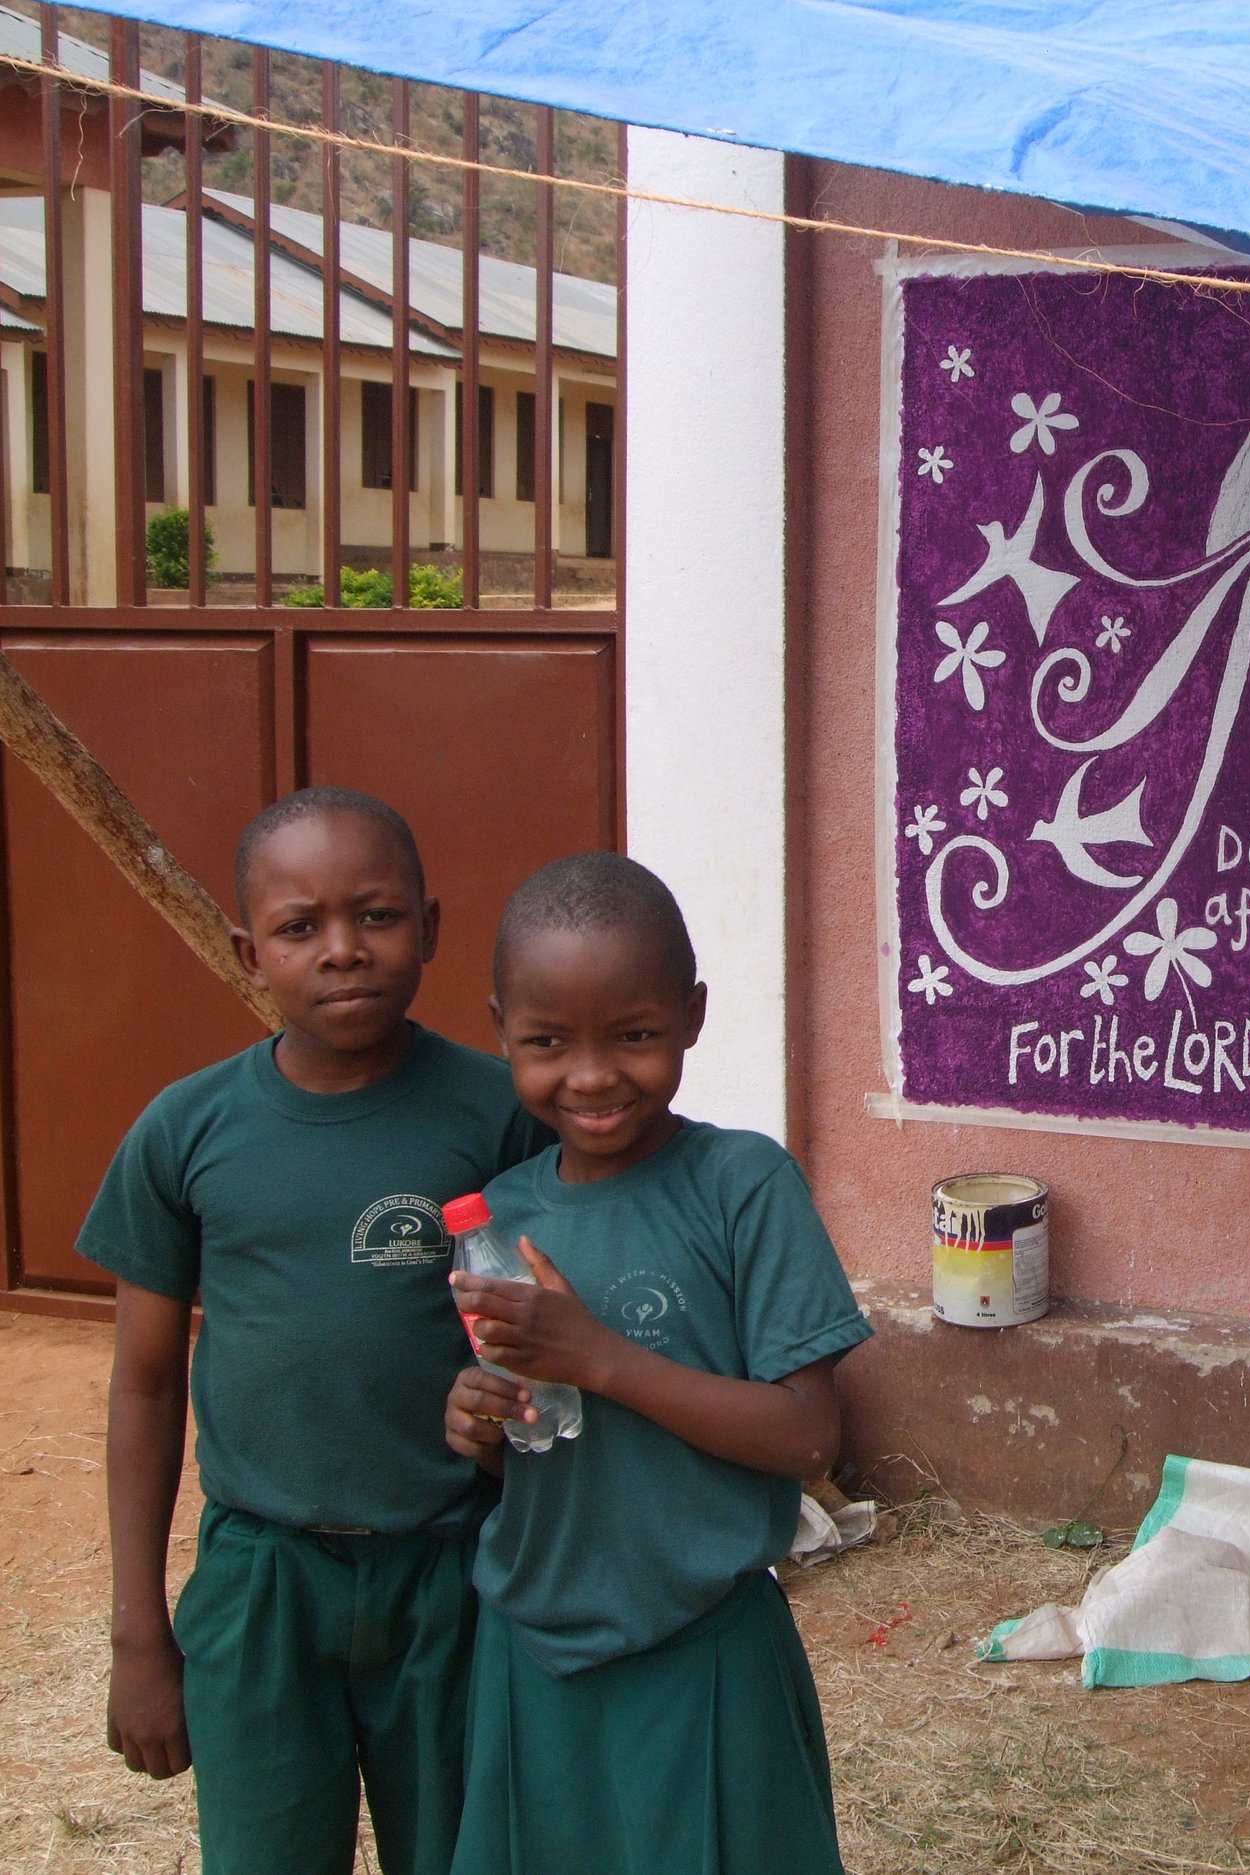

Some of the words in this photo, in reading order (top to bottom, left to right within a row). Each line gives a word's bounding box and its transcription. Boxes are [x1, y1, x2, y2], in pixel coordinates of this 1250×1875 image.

[1008, 1021, 1084, 1085] For
[1090, 1014, 1158, 1084] the
[355, 1220, 369, 1250] LIVING
[364, 1203, 384, 1223] HOPE
[383, 1197, 400, 1208] PRE
[401, 1197, 408, 1205] &
[409, 1197, 441, 1217] PRIMARY
[660, 1273, 687, 1312] MISSION
[626, 1329, 661, 1338] YWAM
